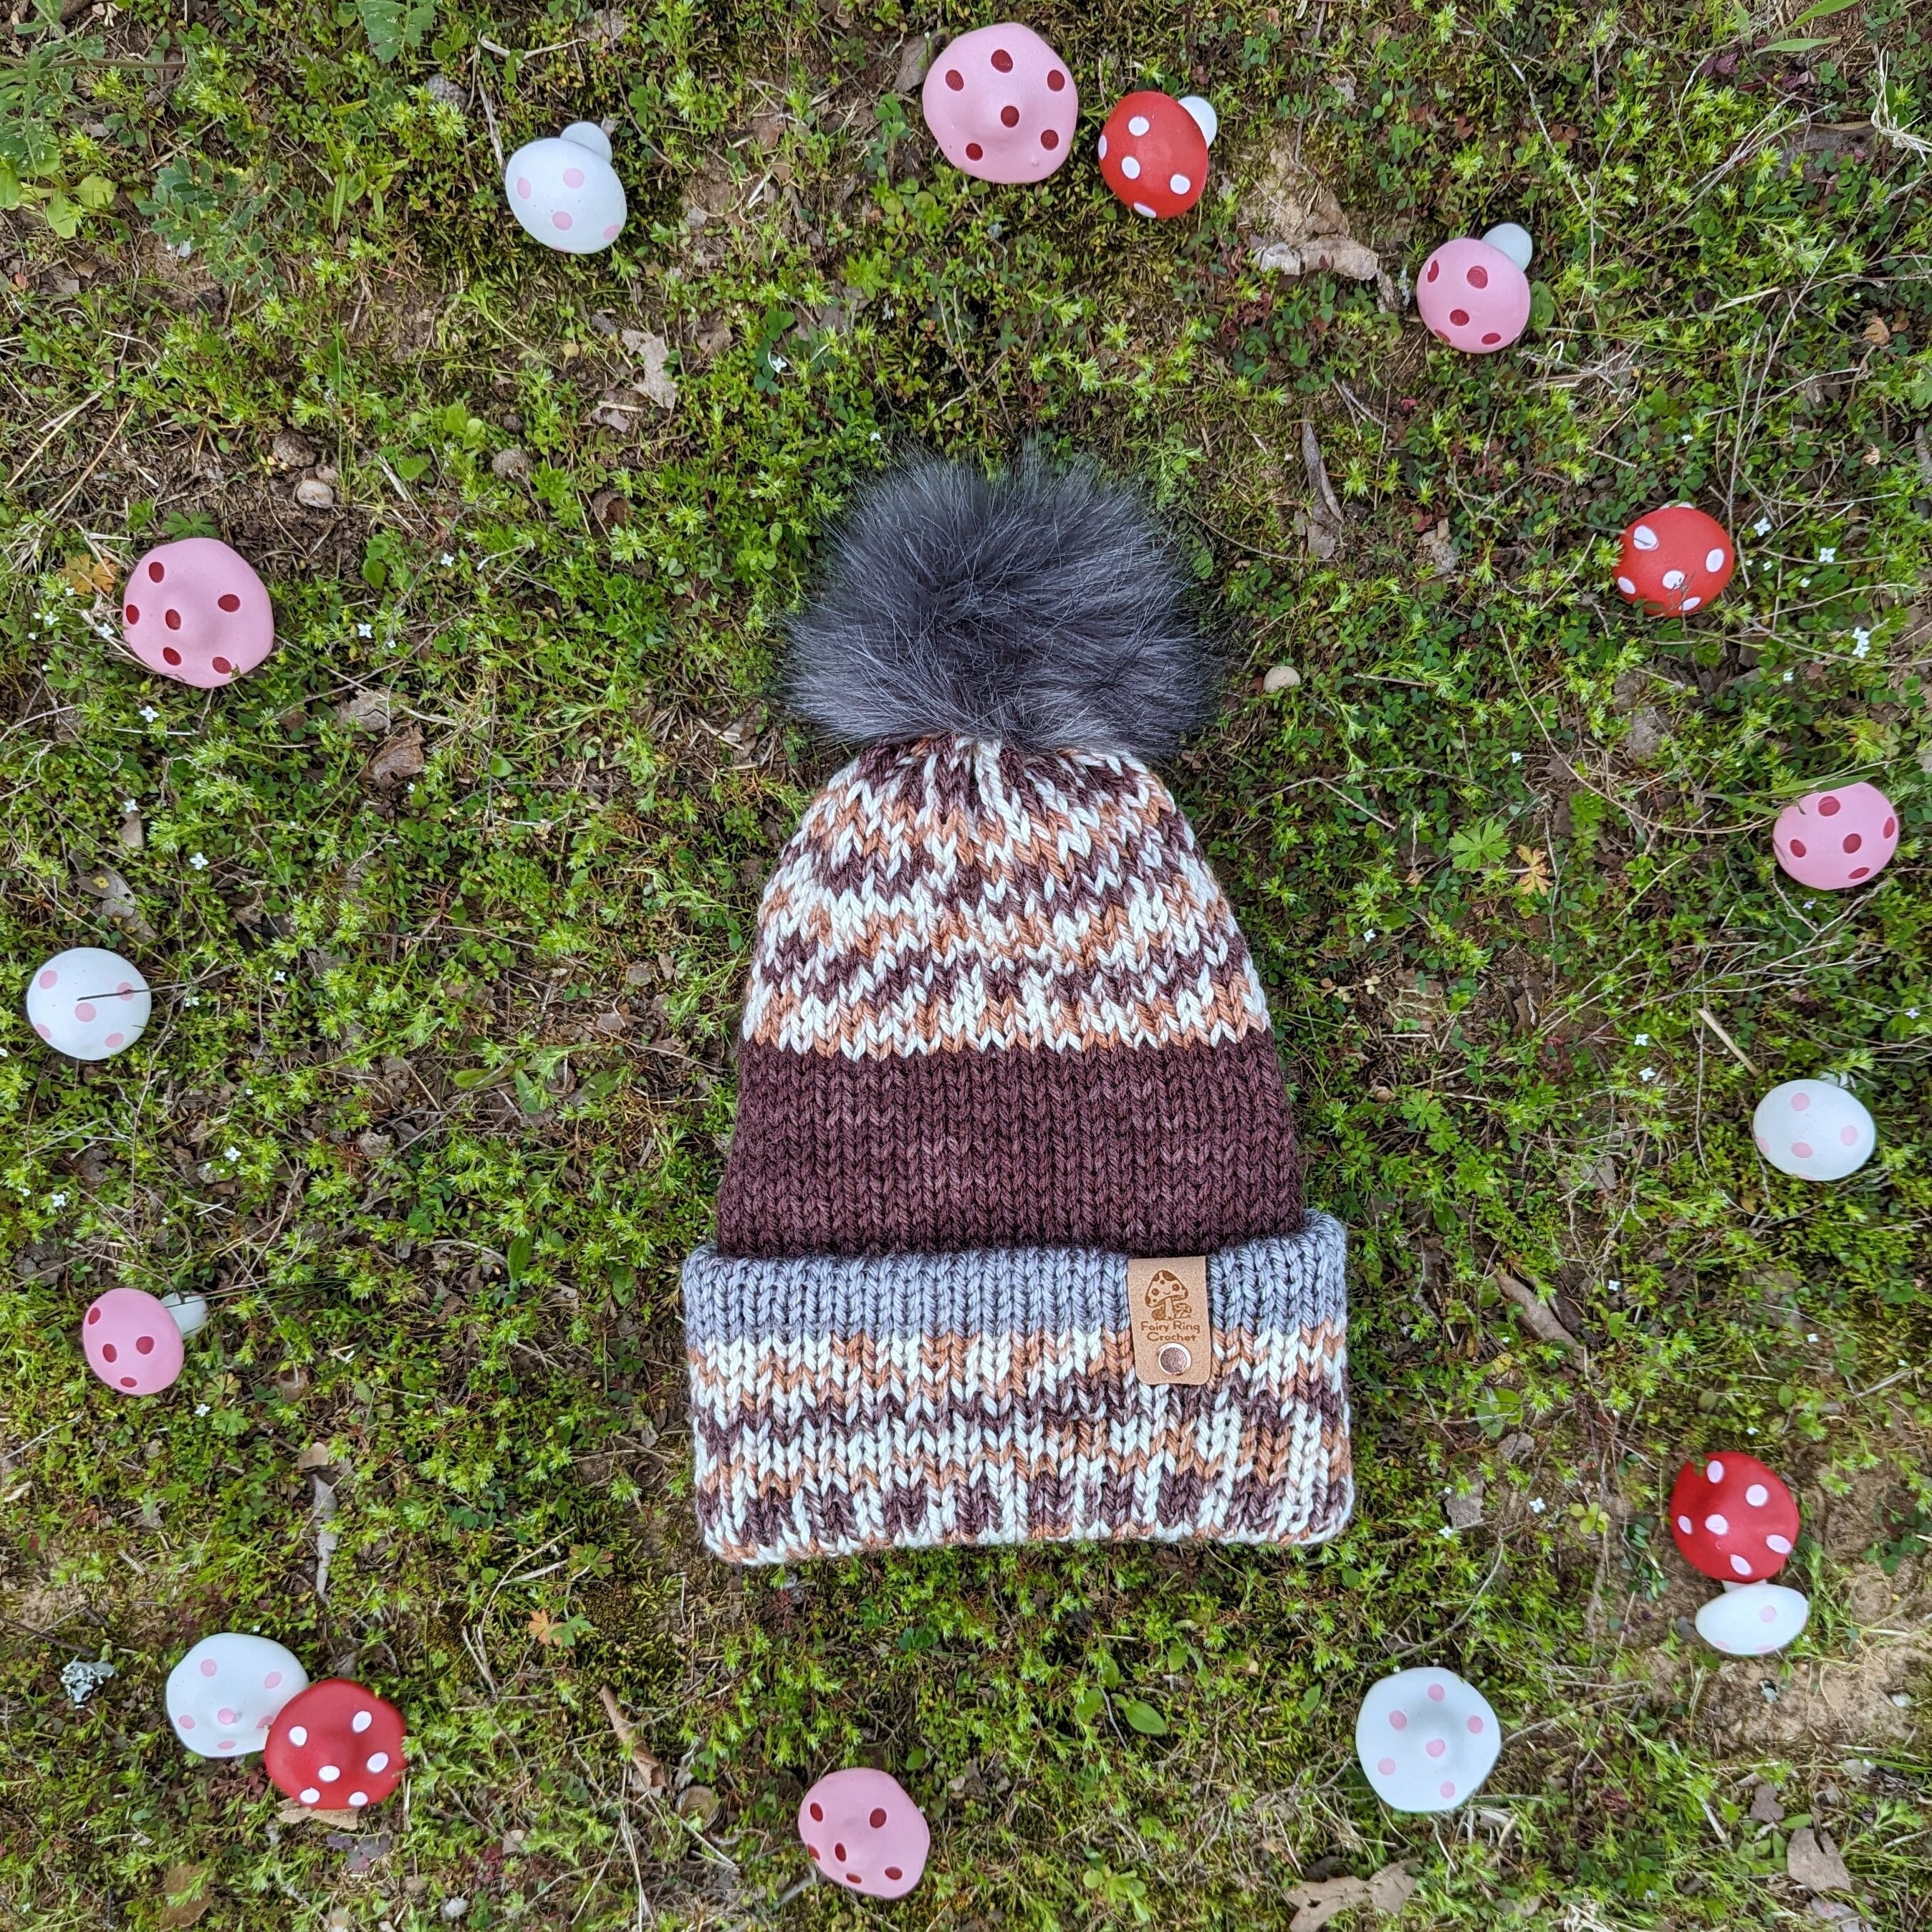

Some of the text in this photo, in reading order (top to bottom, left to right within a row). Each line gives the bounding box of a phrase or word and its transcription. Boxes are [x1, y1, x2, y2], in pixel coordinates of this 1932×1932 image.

[1140, 1320, 1201, 1333] Fairy Ring
[1147, 1332, 1196, 1341] Crochet
